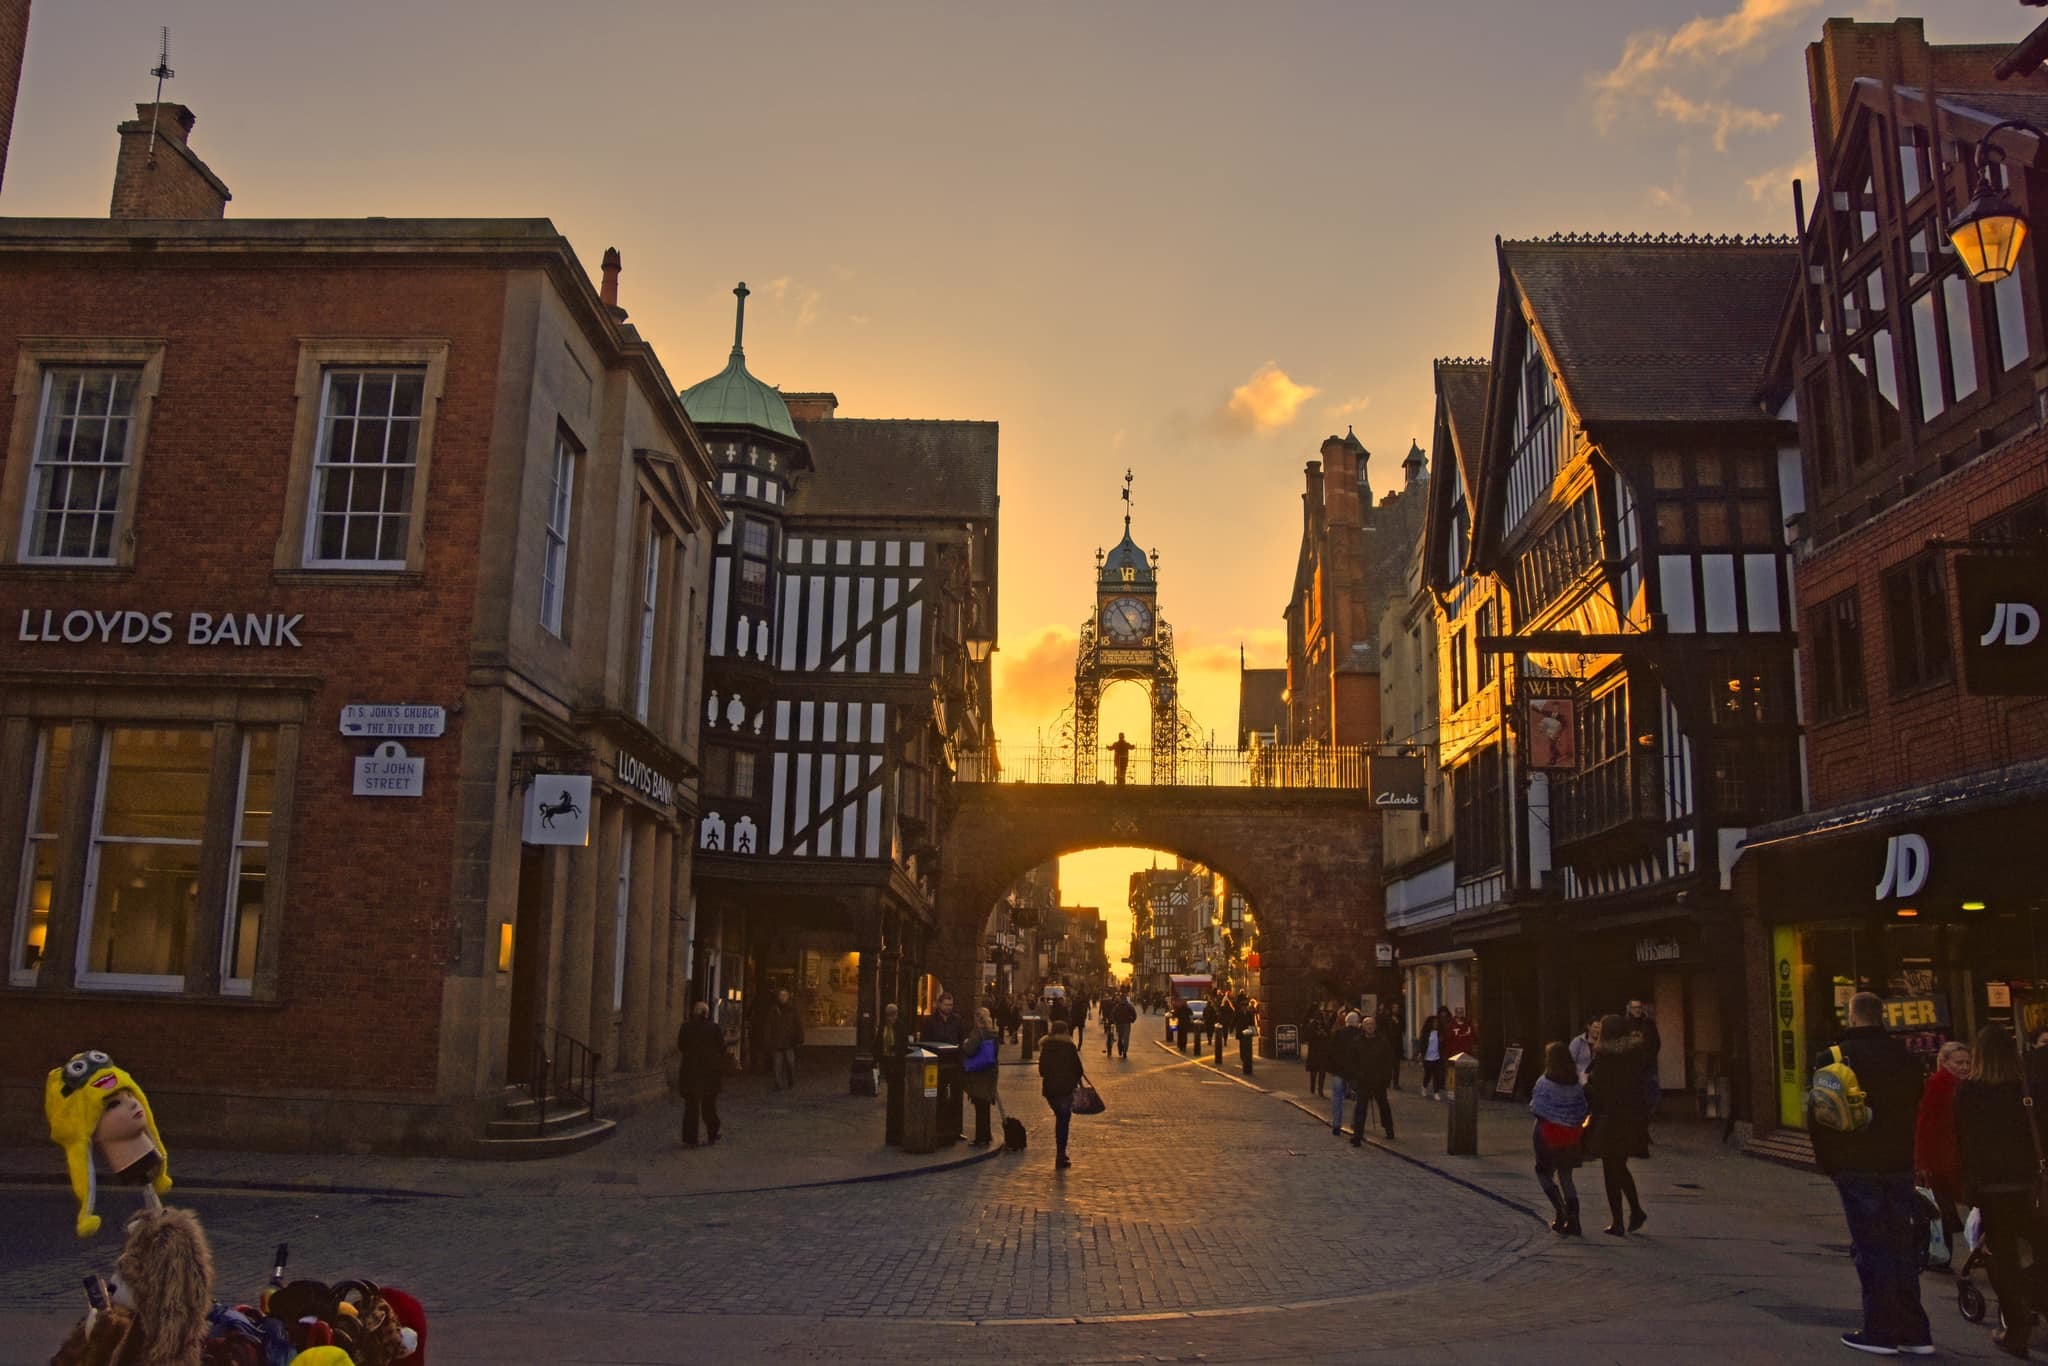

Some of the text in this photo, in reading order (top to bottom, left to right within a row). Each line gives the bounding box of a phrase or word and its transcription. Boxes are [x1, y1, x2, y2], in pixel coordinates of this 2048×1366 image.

[18, 608, 305, 647] LLOYDS BANK
[1979, 602, 2041, 647] JD
[1527, 679, 1573, 697] WHS
[370, 707, 401, 719] JOHN'S
[404, 707, 440, 719] CHURCH
[366, 723, 385, 735] THE
[387, 723, 415, 735] RIVER
[363, 762, 416, 775] ST JOHN
[618, 749, 652, 794] LLOYDS
[365, 777, 411, 790] STREET
[1375, 791, 1419, 806] Clarks
[1875, 832, 1931, 901] JD
